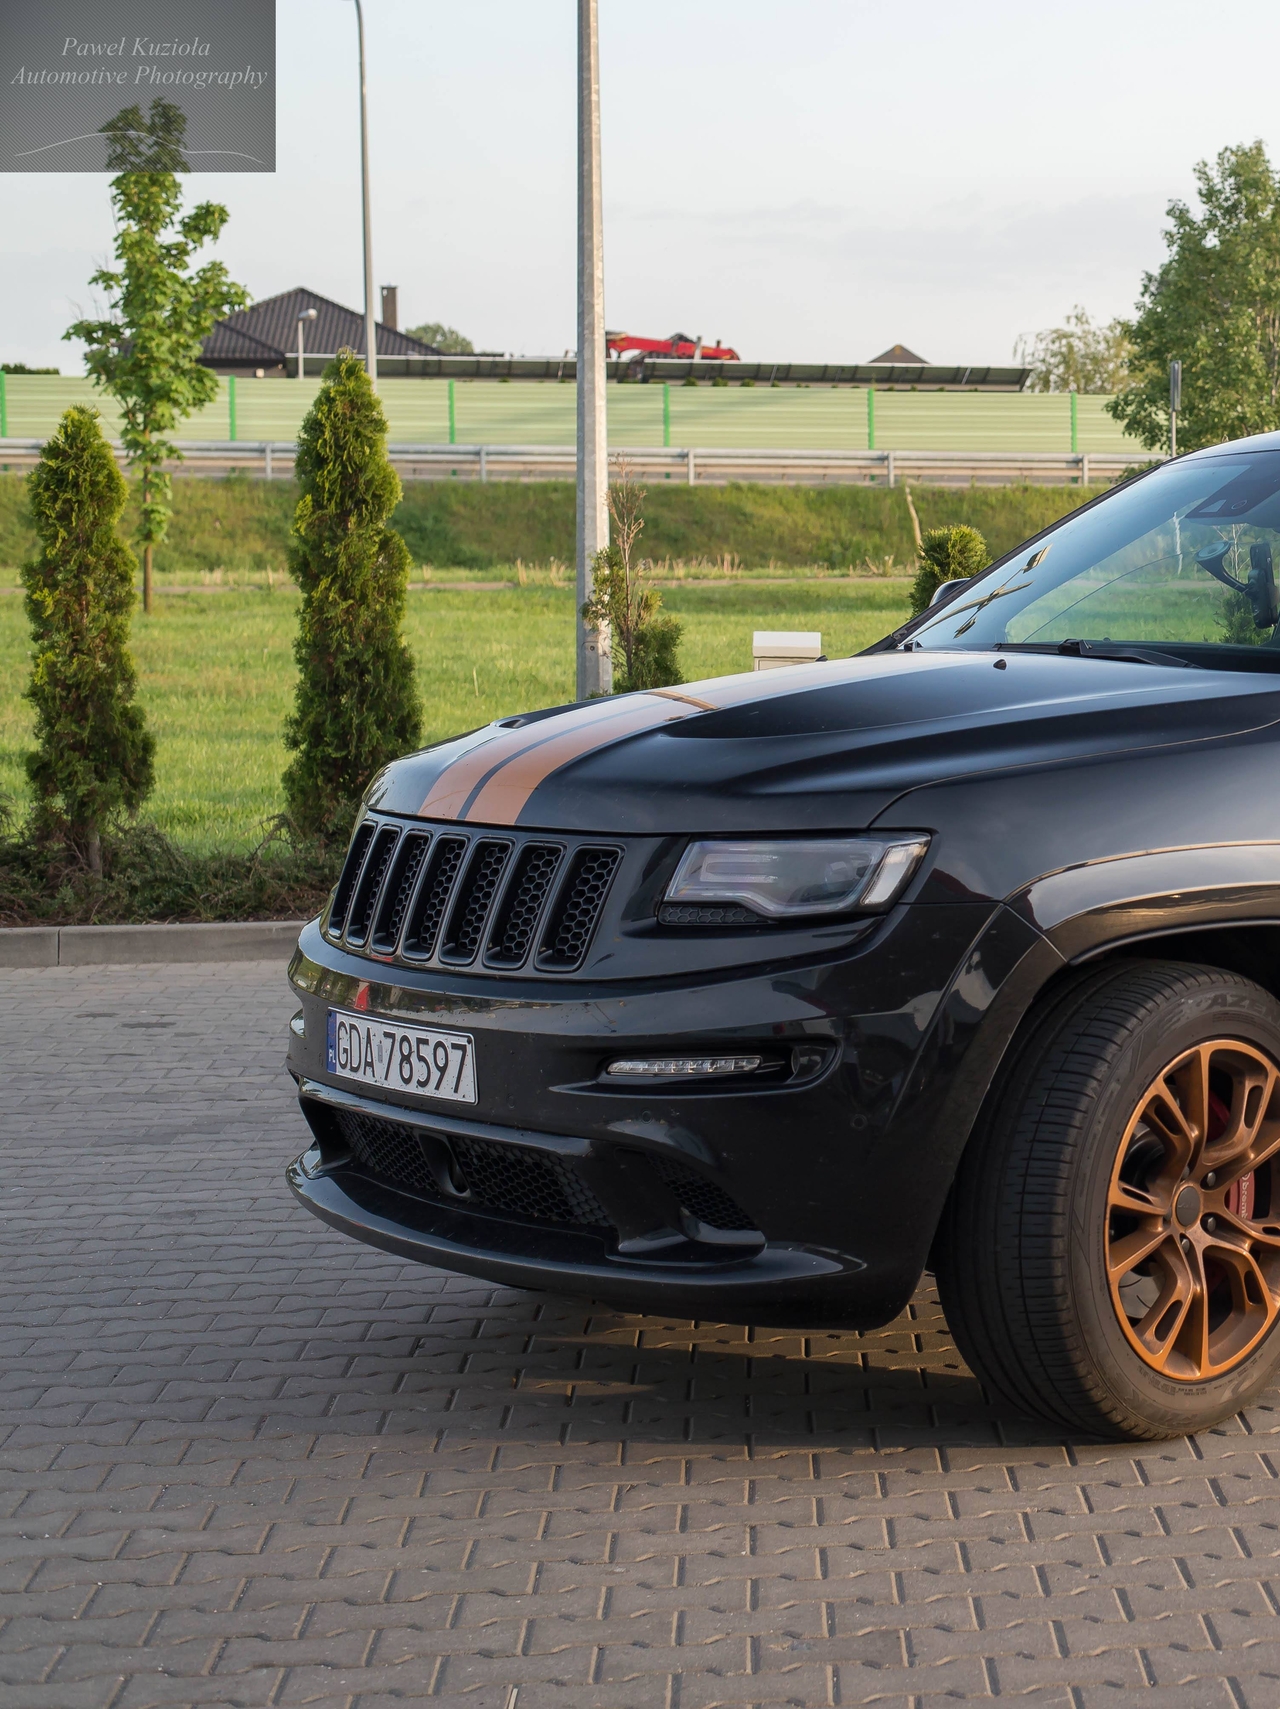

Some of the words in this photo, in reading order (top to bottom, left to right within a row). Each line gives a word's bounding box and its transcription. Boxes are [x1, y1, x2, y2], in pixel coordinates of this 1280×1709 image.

[328, 1049, 336, 1064] PL
[338, 1020, 376, 1078] GDA
[382, 1030, 467, 1093] 78597
